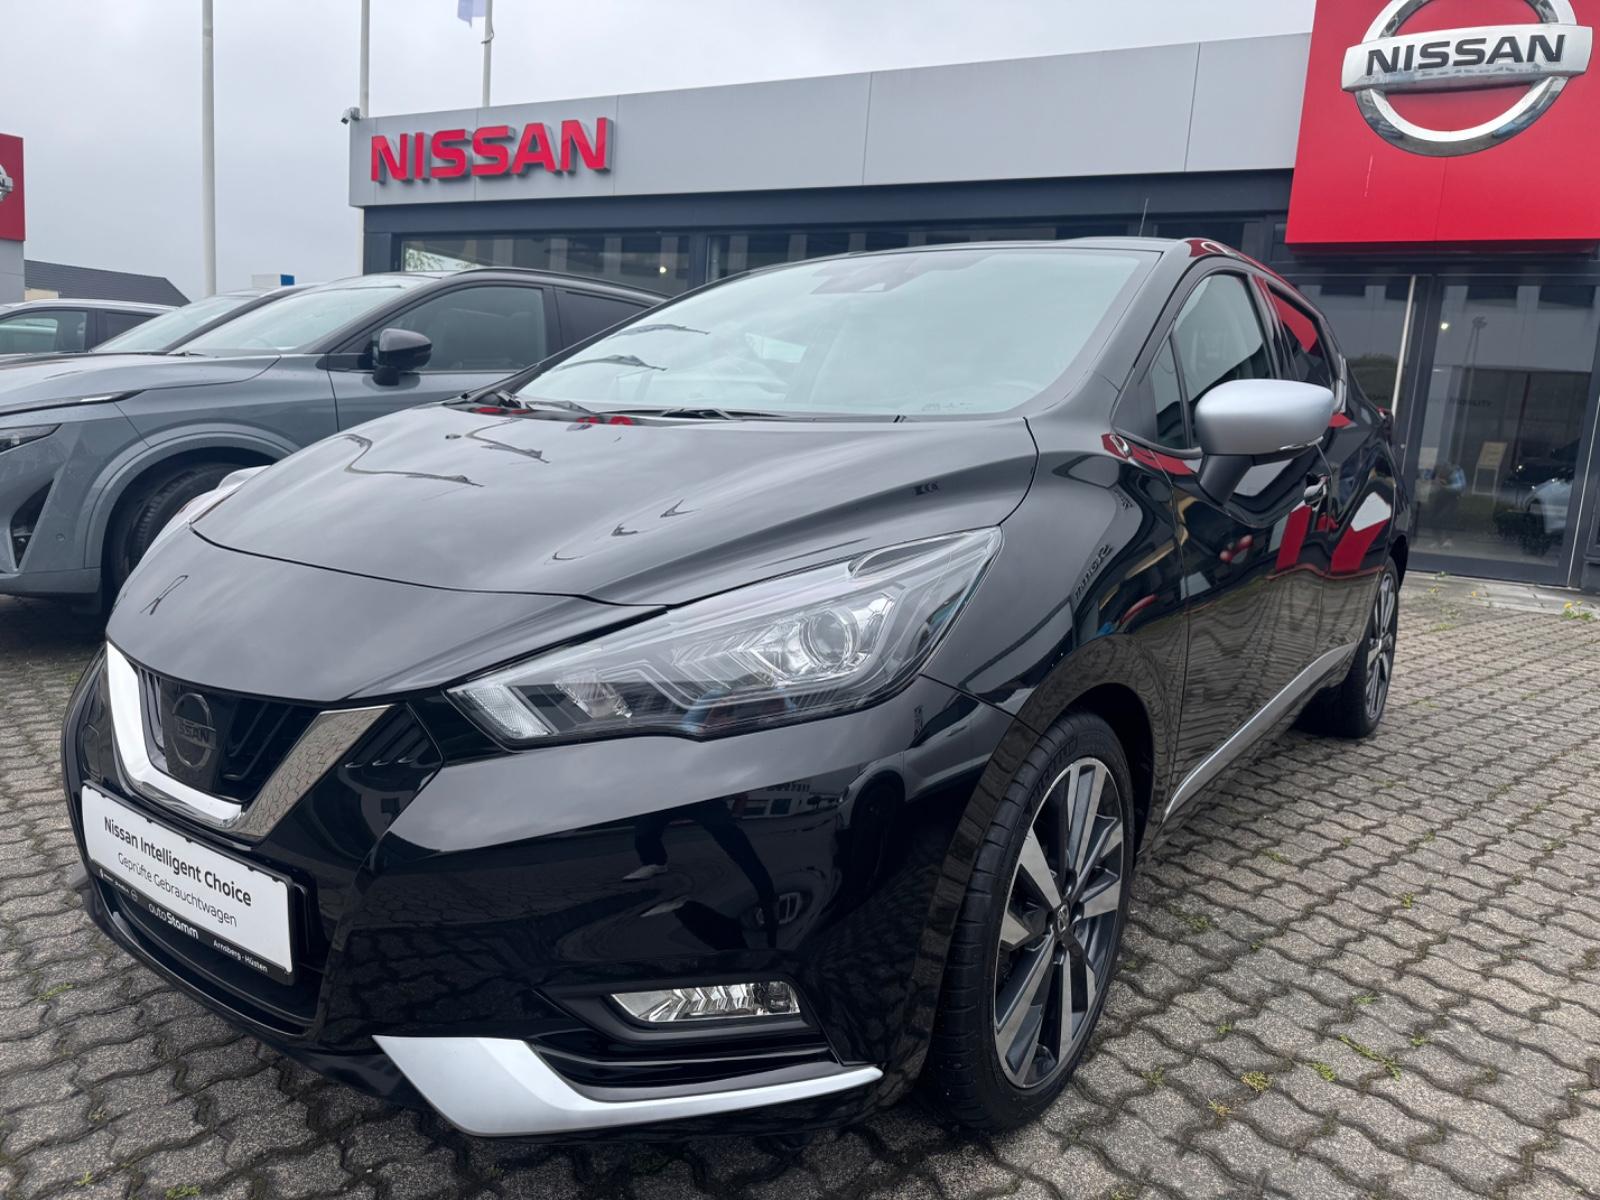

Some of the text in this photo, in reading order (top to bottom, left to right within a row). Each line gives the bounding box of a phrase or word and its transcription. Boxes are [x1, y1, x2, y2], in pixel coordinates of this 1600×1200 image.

[1366, 34, 1566, 76] NISSAN
[371, 116, 611, 184] NISSAN
[104, 816, 139, 849] Nissan
[140, 836, 202, 882] Intelligent
[204, 870, 252, 907] Choice
[118, 852, 152, 882] Geprüfte
[154, 873, 238, 928] Gebrauchtwagen
